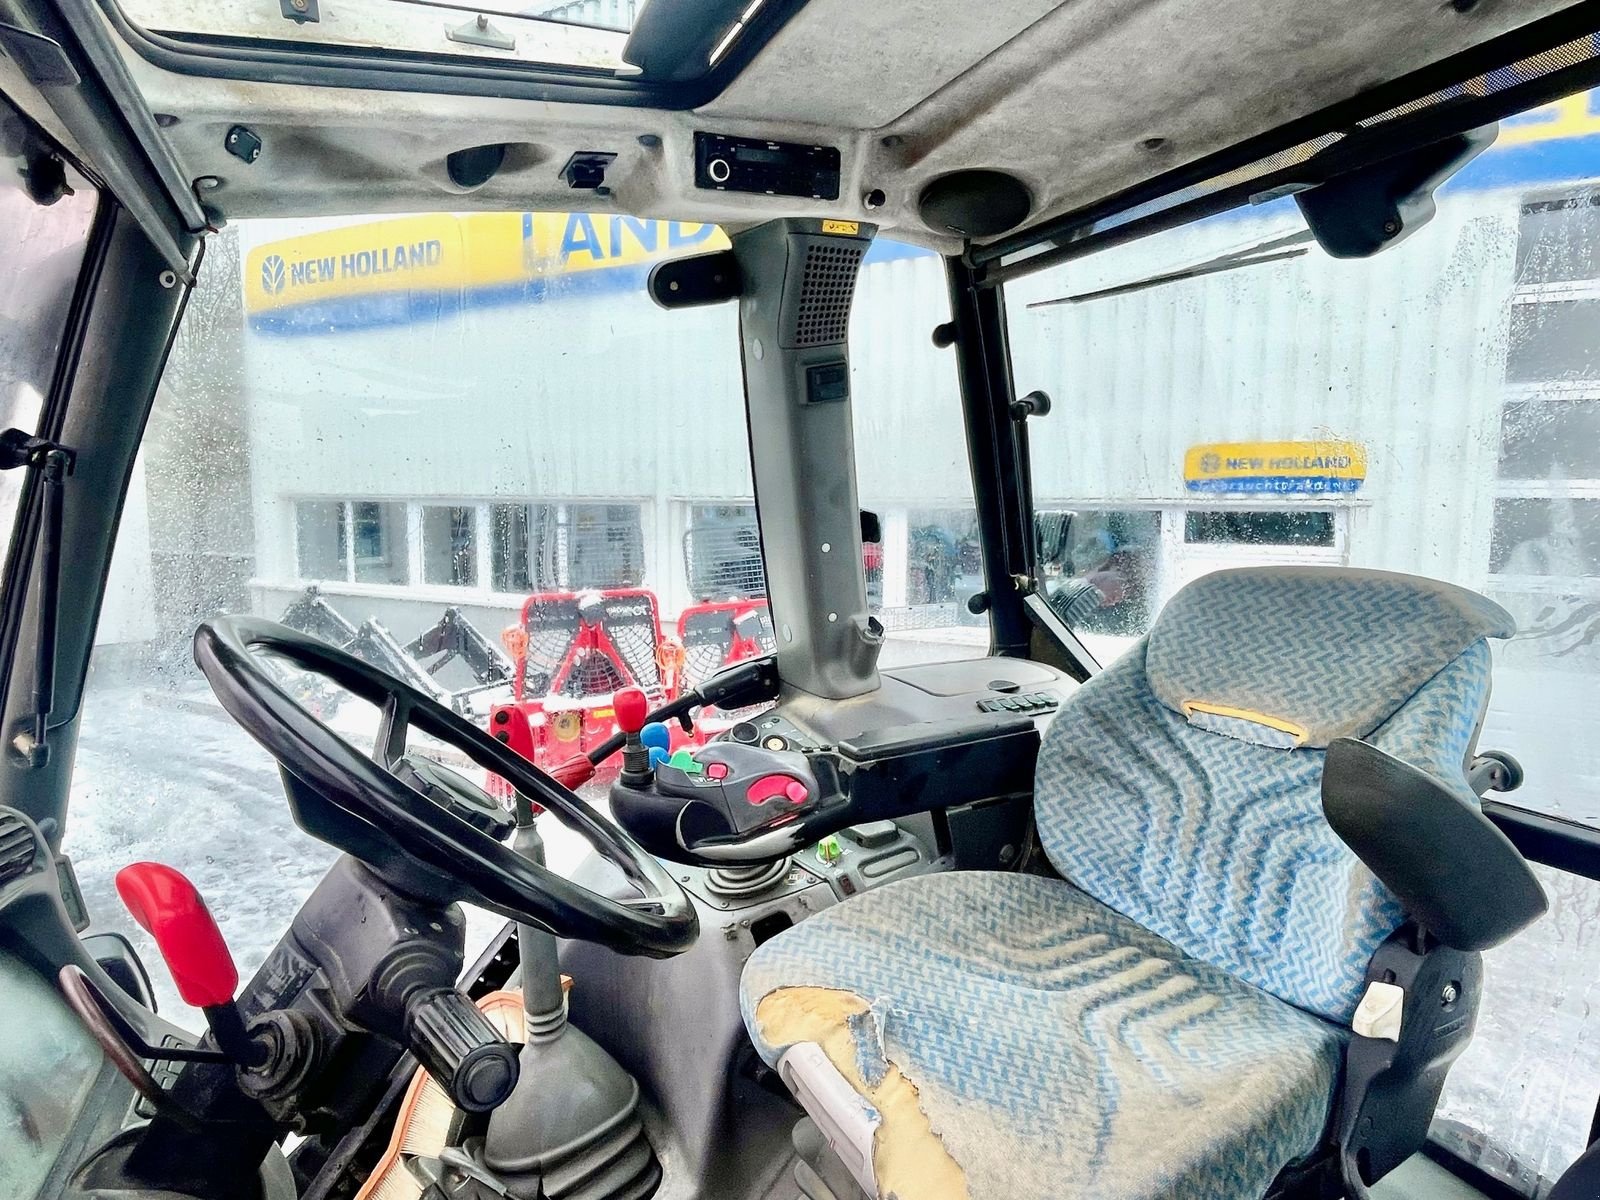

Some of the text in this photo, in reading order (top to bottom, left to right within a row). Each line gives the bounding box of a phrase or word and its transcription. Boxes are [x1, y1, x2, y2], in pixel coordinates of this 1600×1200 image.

[290, 239, 441, 287] NEW HOLLAND
[1226, 455, 1351, 470] NEW HOLLAND
